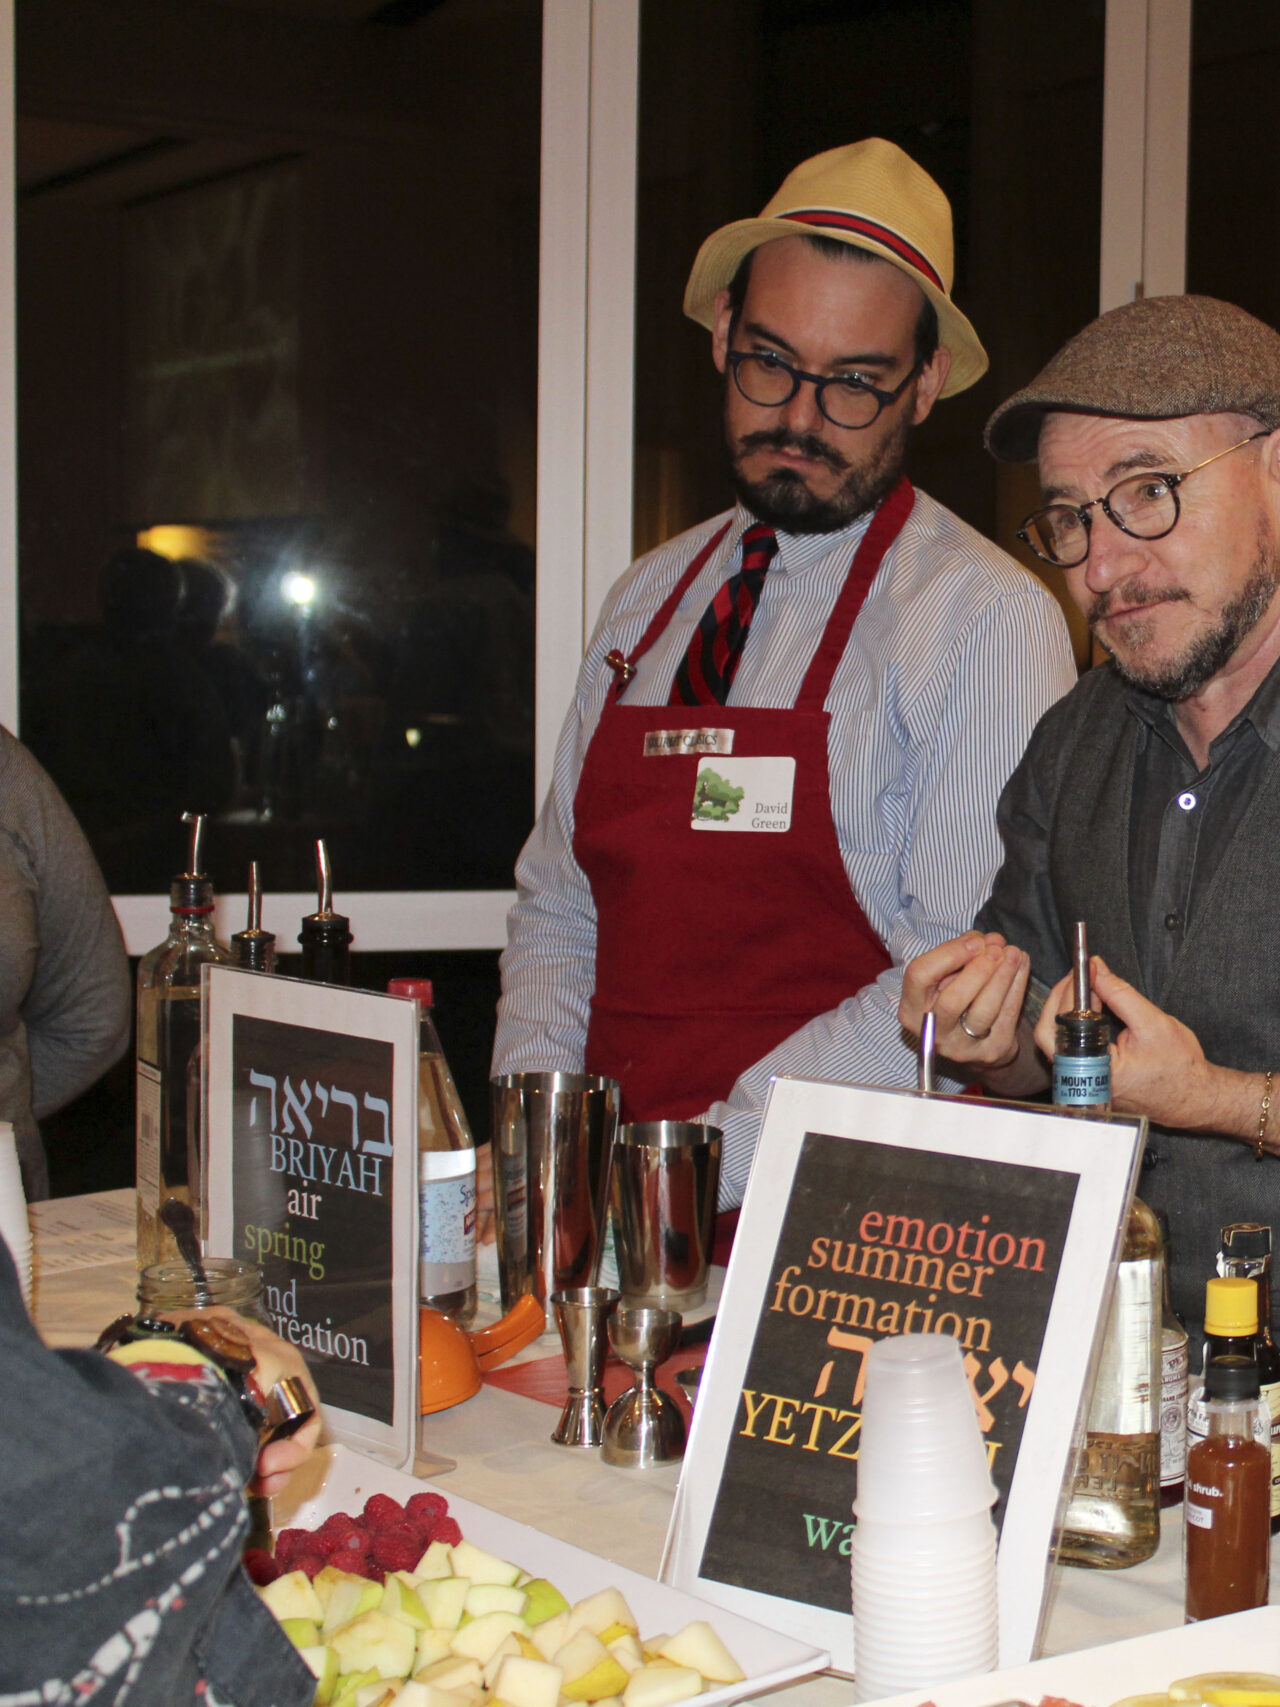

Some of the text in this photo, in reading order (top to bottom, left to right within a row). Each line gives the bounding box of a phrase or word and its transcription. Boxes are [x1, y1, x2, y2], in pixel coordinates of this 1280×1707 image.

[751, 817, 787, 829] Green
[754, 802, 788, 814] David
[1061, 1075, 1093, 1087] MOUNT
[1068, 1087, 1087, 1098] 1703
[249, 1068, 394, 1158] בריאה
[269, 1134, 383, 1197] BRIYAH
[287, 1180, 322, 1220] air
[245, 1222, 325, 1280] spring
[807, 1237, 994, 1297] summer
[859, 1211, 1046, 1272] emotion
[770, 1266, 992, 1352] formation
[272, 1313, 369, 1366] reation
[1193, 1483, 1224, 1497] shrub.
